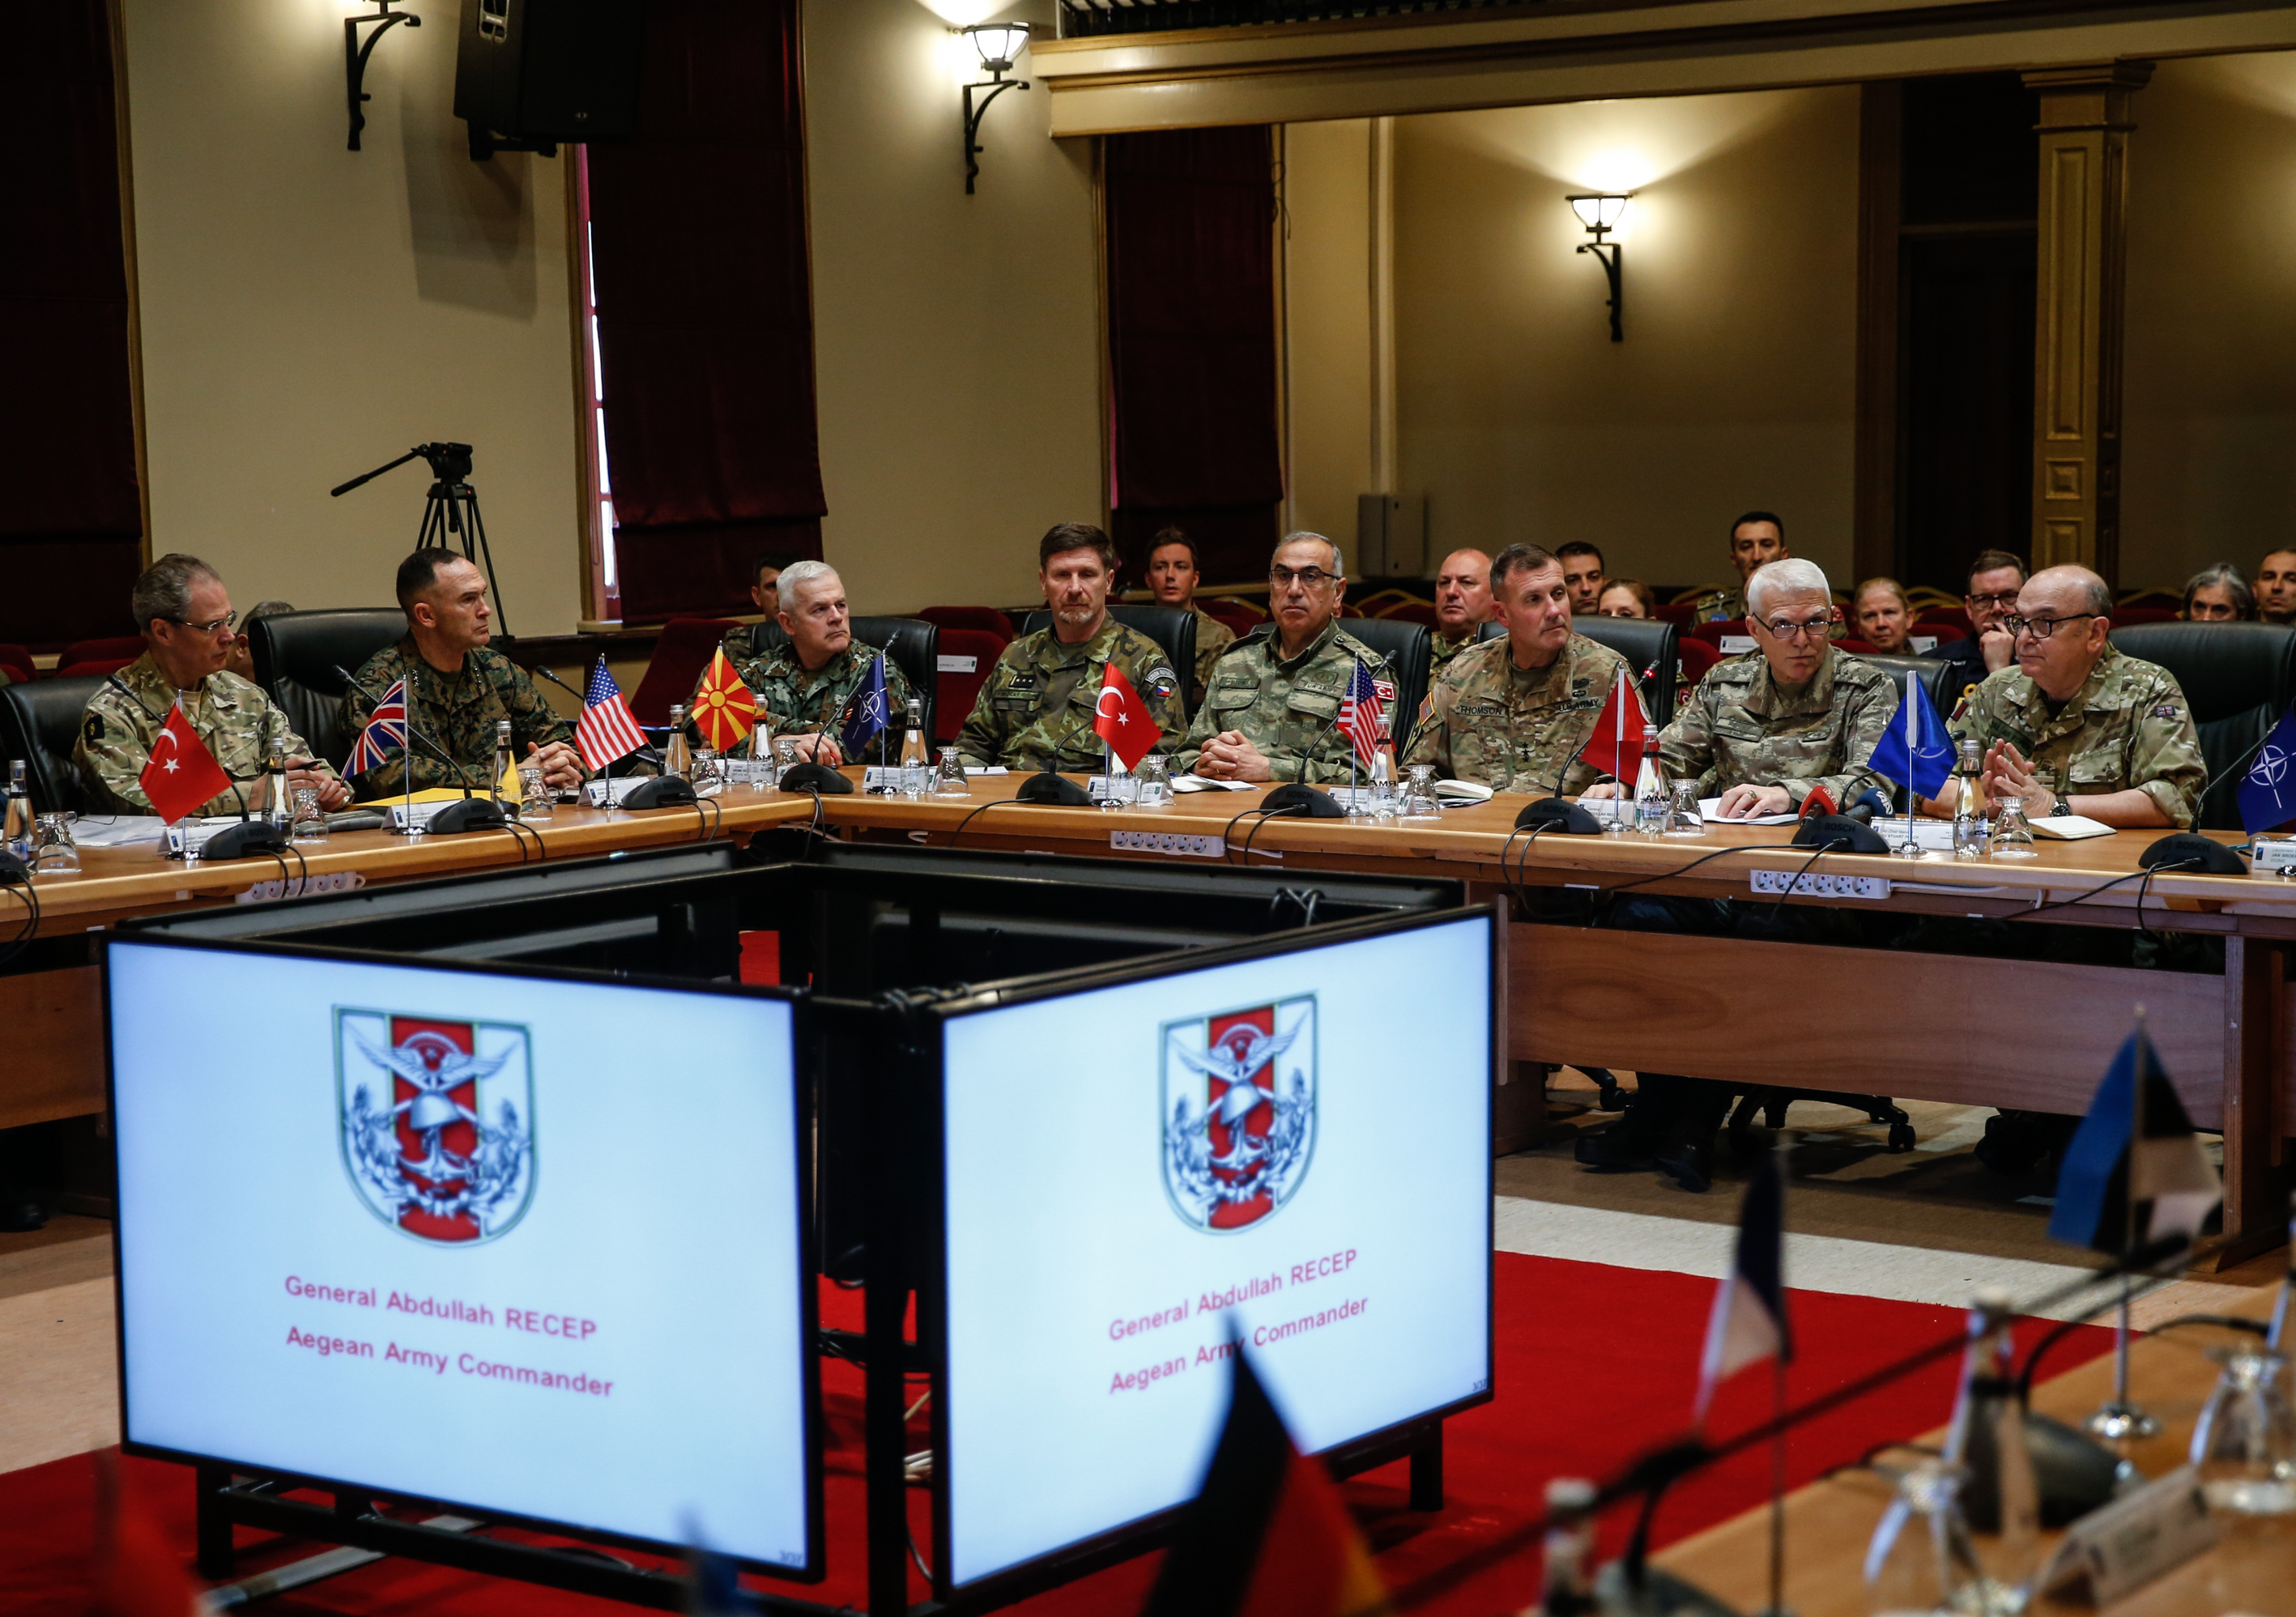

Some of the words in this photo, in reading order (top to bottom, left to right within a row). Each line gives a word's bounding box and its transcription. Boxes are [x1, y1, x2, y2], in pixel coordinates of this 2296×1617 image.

[1459, 704, 1502, 716] THOMSON
[1574, 699, 1600, 710] ARMY
[662, 781, 684, 790] BOSCH
[1286, 790, 1313, 799] BOSCH
[1543, 805, 1570, 815] BOSCH
[249, 828, 271, 837] BOSCH
[1825, 823, 1855, 832] BOSCH
[2175, 840, 2211, 852] BOSCH
[1109, 1300, 1188, 1341] General
[1197, 1273, 1282, 1315] Abdullah
[1290, 1249, 1357, 1286] RECEP
[285, 1275, 377, 1308] General
[386, 1290, 494, 1326] Abdullah
[505, 1308, 597, 1340] RECEP
[1110, 1355, 1186, 1394] Aegean
[1254, 1297, 1368, 1347] Commander
[286, 1326, 374, 1357] Aegean
[385, 1343, 448, 1375] Army
[458, 1353, 614, 1396] Commander
